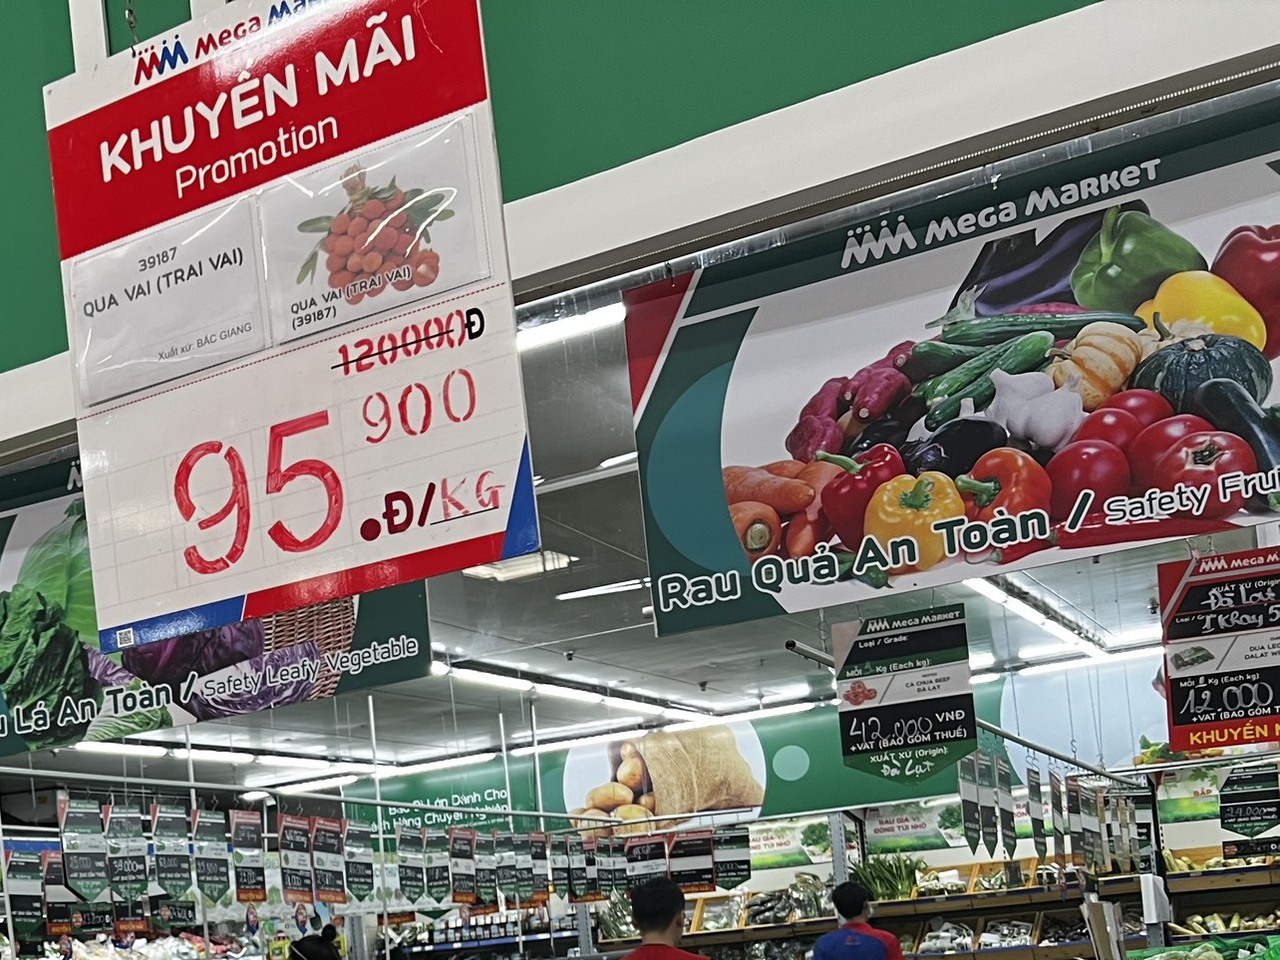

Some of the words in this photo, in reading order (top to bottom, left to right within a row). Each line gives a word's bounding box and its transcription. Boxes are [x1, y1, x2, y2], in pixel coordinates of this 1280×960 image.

[100, 57, 298, 183] KHUYẾN
[314, 11, 417, 97] MÃI
[175, 114, 339, 199] Promotion
[138, 247, 178, 273] 39187
[83, 292, 119, 319] QUA
[123, 281, 152, 307] VAI
[156, 262, 205, 297] (TRAI
[207, 245, 244, 277] VAI)
[290, 295, 318, 316] QUA
[321, 288, 344, 306] VAI
[346, 273, 382, 302] (TRAI
[384, 264, 412, 286] VAI)
[290, 306, 338, 331] (39187)
[219, 322, 253, 343] GIANG
[173, 409, 344, 575] 95
[361, 367, 477, 444] 900
[658, 570, 742, 611] Rau
[750, 535, 840, 596] Quả
[852, 532, 919, 575] An
[933, 503, 1050, 560] Toàn
[1104, 482, 1211, 526] Safety
[875, 665, 887, 674] Kg
[889, 661, 915, 673] (Each
[1244, 651, 1268, 660] DALAT
[14, 696, 51, 737] Lá
[56, 696, 98, 727] An
[105, 678, 173, 716] Toàn
[202, 672, 261, 700] Safety
[265, 658, 321, 689] Leafy
[325, 635, 419, 676] Vegetable
[1208, 677, 1219, 686] Kg
[1221, 674, 1245, 684] (Each
[1191, 712, 1216, 723] +VAT
[1219, 709, 1245, 721] (BAO
[850, 740, 876, 752] +VAT
[878, 736, 904, 748] (BAO
[934, 725, 968, 740] THUẾ)
[1189, 719, 1269, 746] KHUYẾN
[484, 788, 507, 801] Cho
